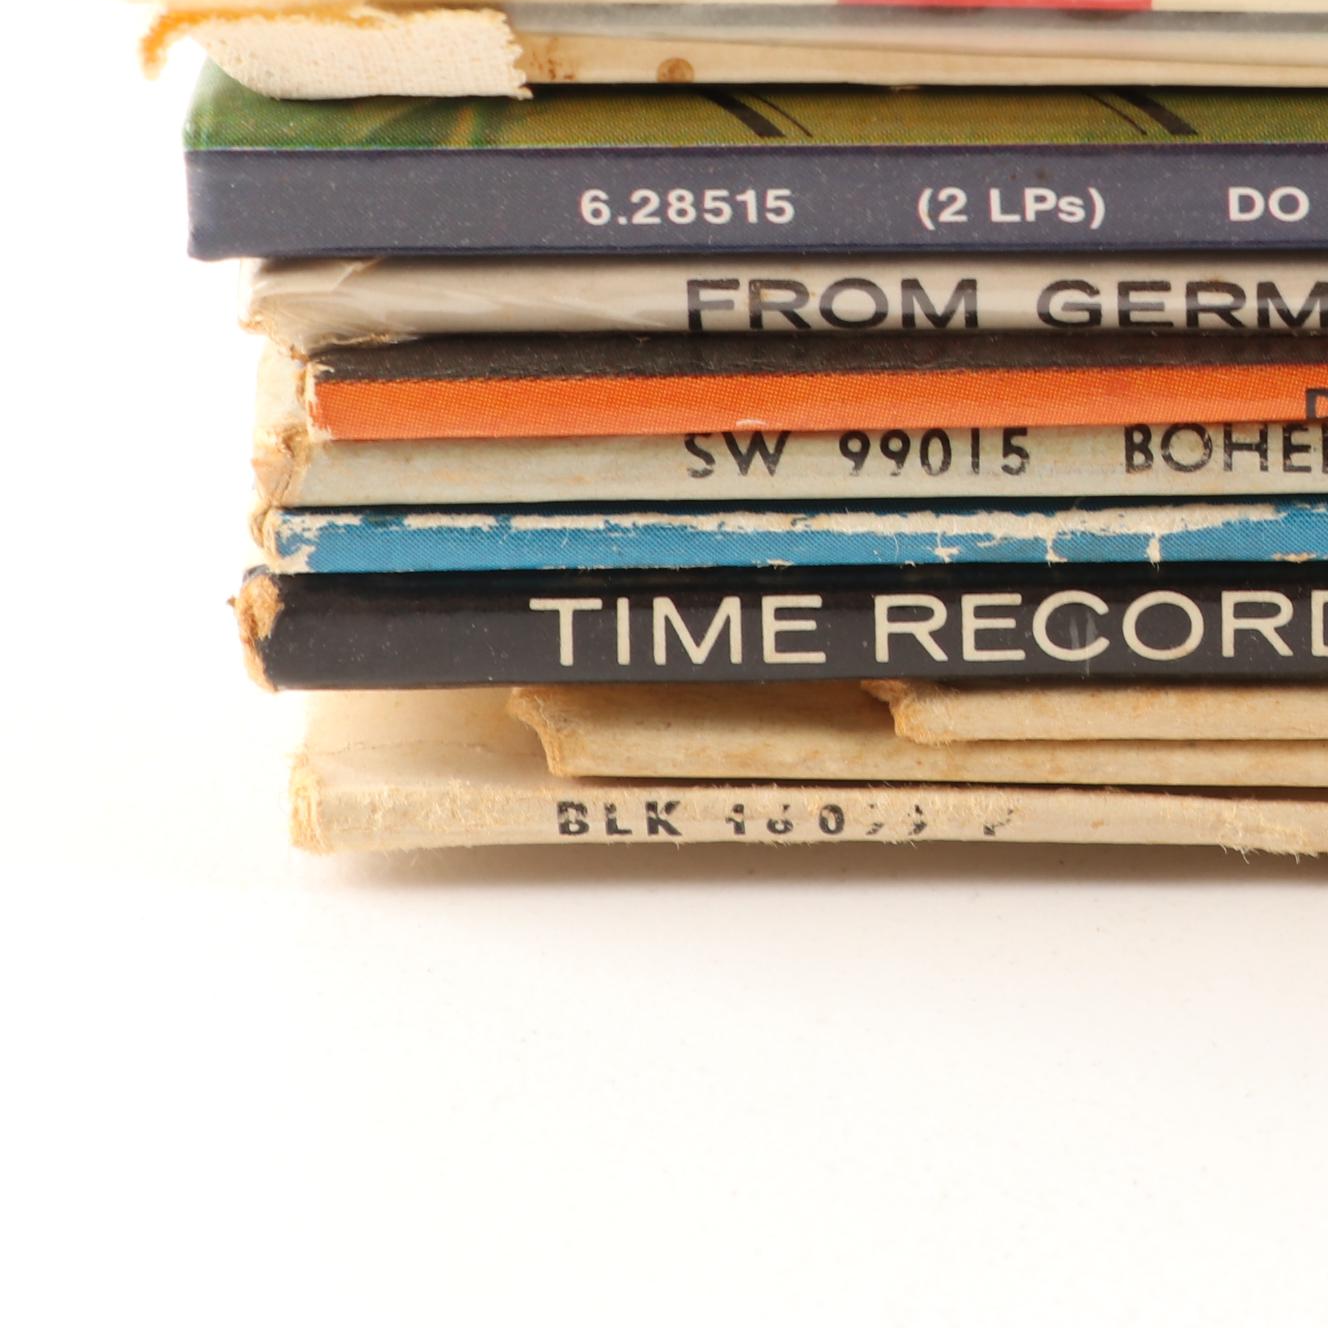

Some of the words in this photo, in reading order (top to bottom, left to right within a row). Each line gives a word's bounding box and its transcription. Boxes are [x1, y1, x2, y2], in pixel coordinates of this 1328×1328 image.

[578, 187, 797, 227] 6.28515
[916, 185, 969, 229] (2
[988, 185, 1107, 230] LPs)
[1227, 186, 1312, 224] DO
[686, 277, 979, 331] FROM
[683, 430, 792, 478] SW
[838, 427, 1031, 476] 99015
[528, 594, 827, 667] TIME
[556, 799, 684, 838] BLK
